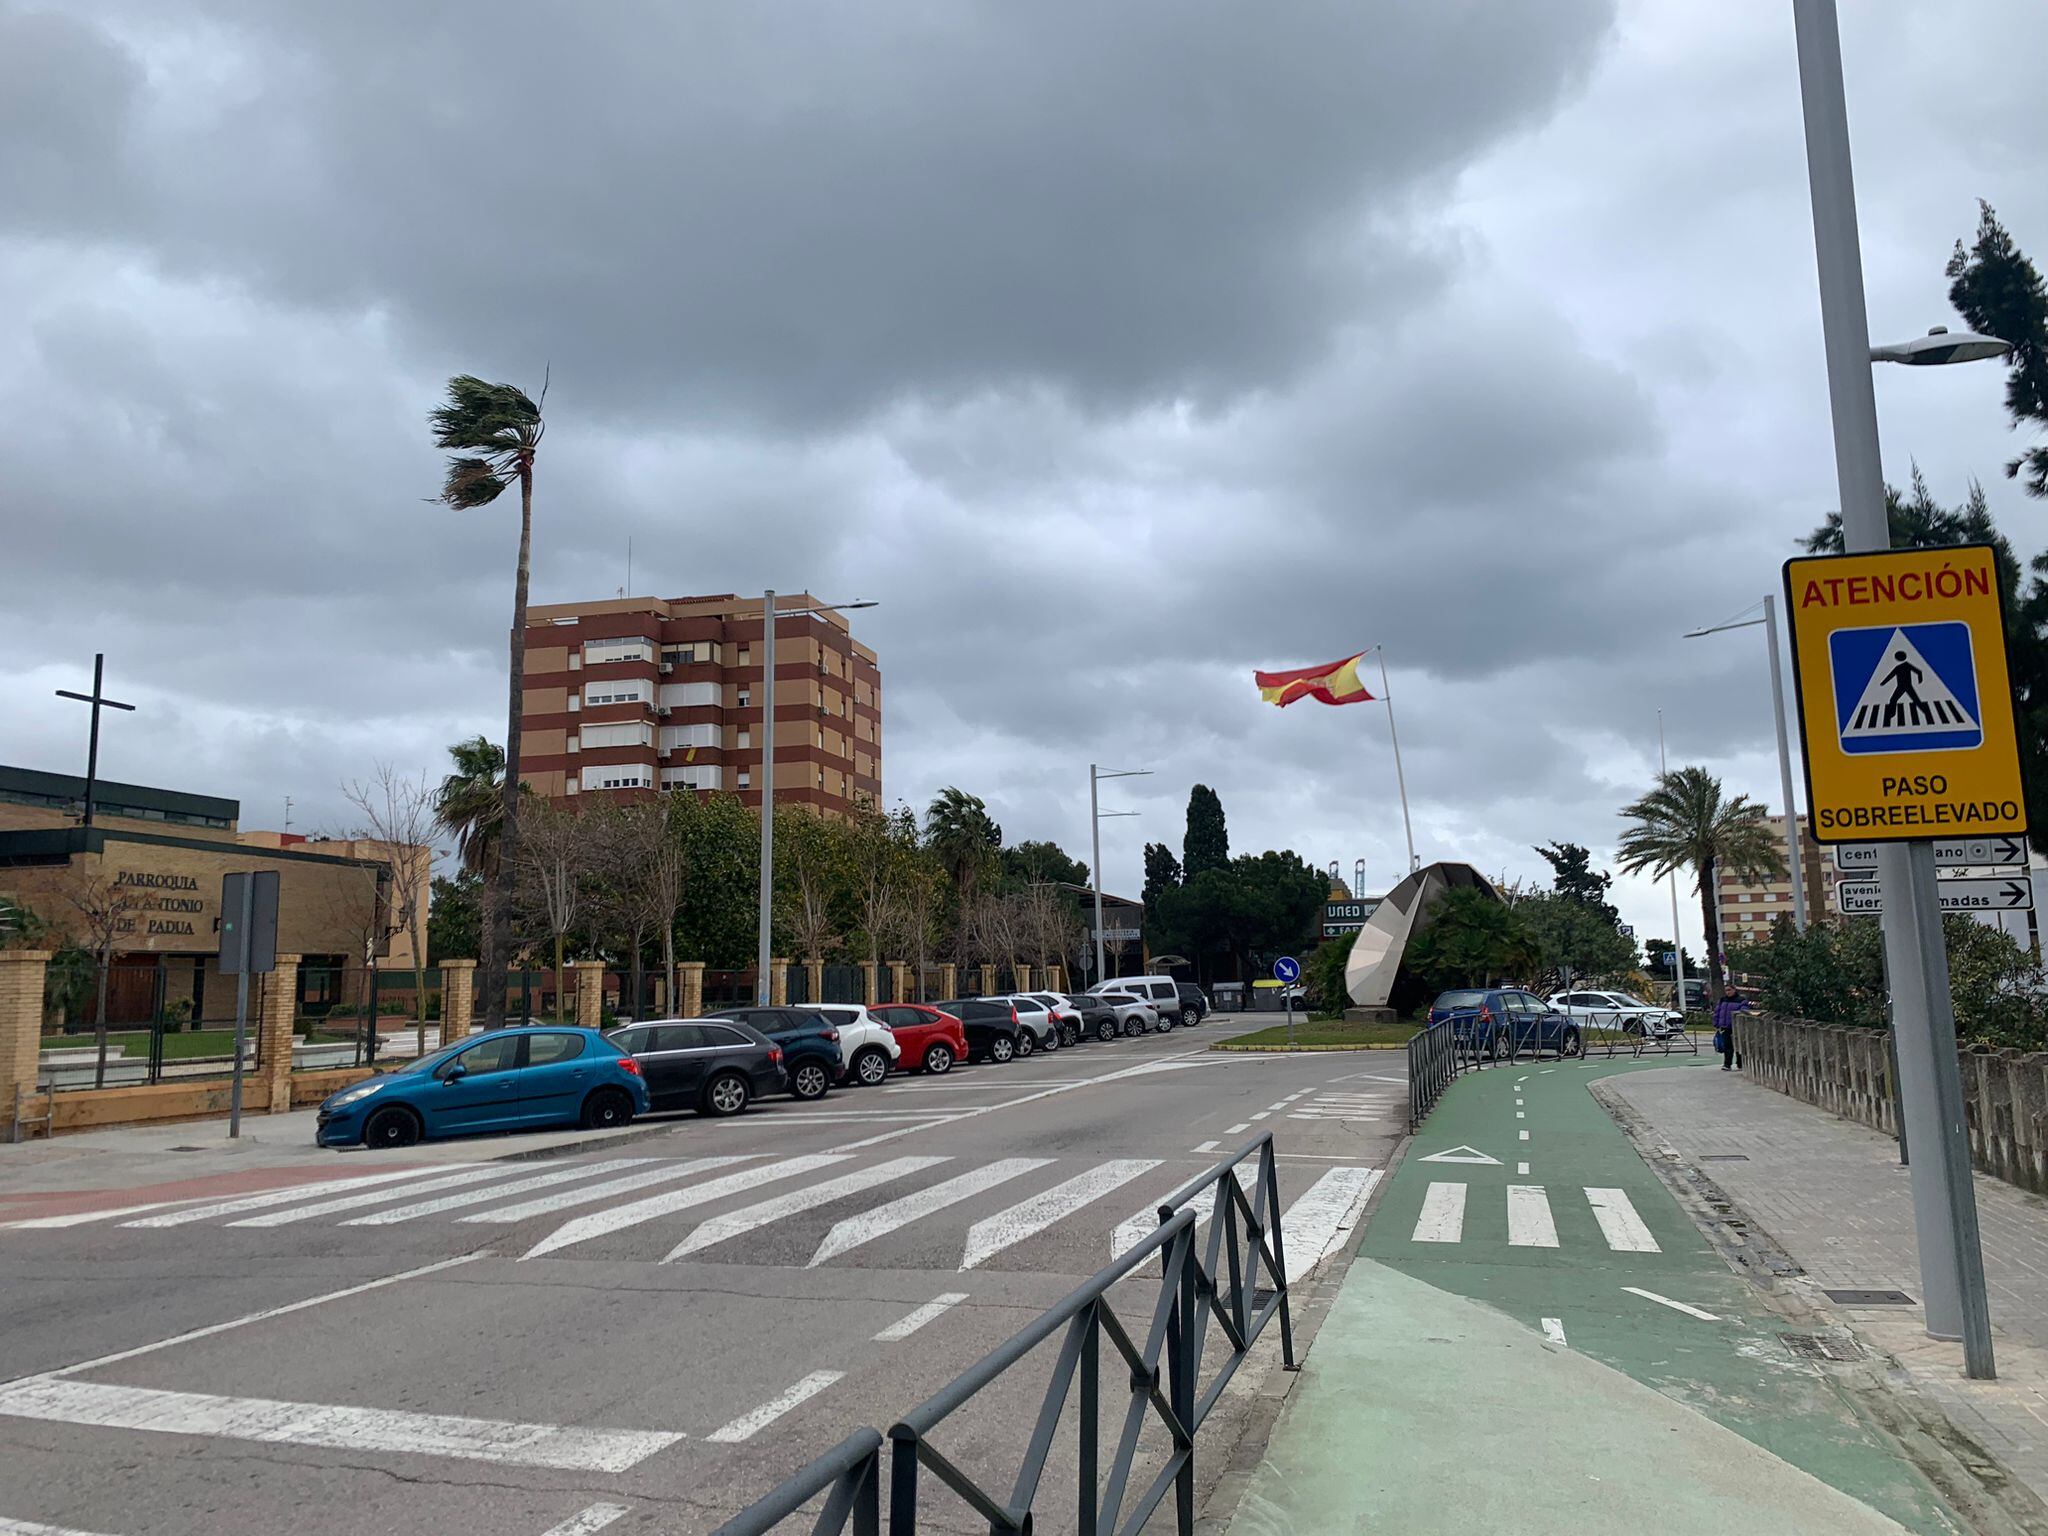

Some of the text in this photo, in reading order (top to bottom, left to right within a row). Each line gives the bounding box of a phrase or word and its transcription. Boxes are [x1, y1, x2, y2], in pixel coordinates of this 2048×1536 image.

[1802, 562, 1990, 608] ATENCIÓN
[1882, 775, 1948, 796] PASO
[1820, 801, 2019, 828] SOBREELEVADO
[117, 871, 198, 890] PARROQUIA
[1844, 885, 1881, 895] aveni
[1327, 905, 1361, 917] UNED
[1845, 897, 1883, 909] Fuer
[116, 918, 195, 935] DE PADUA
